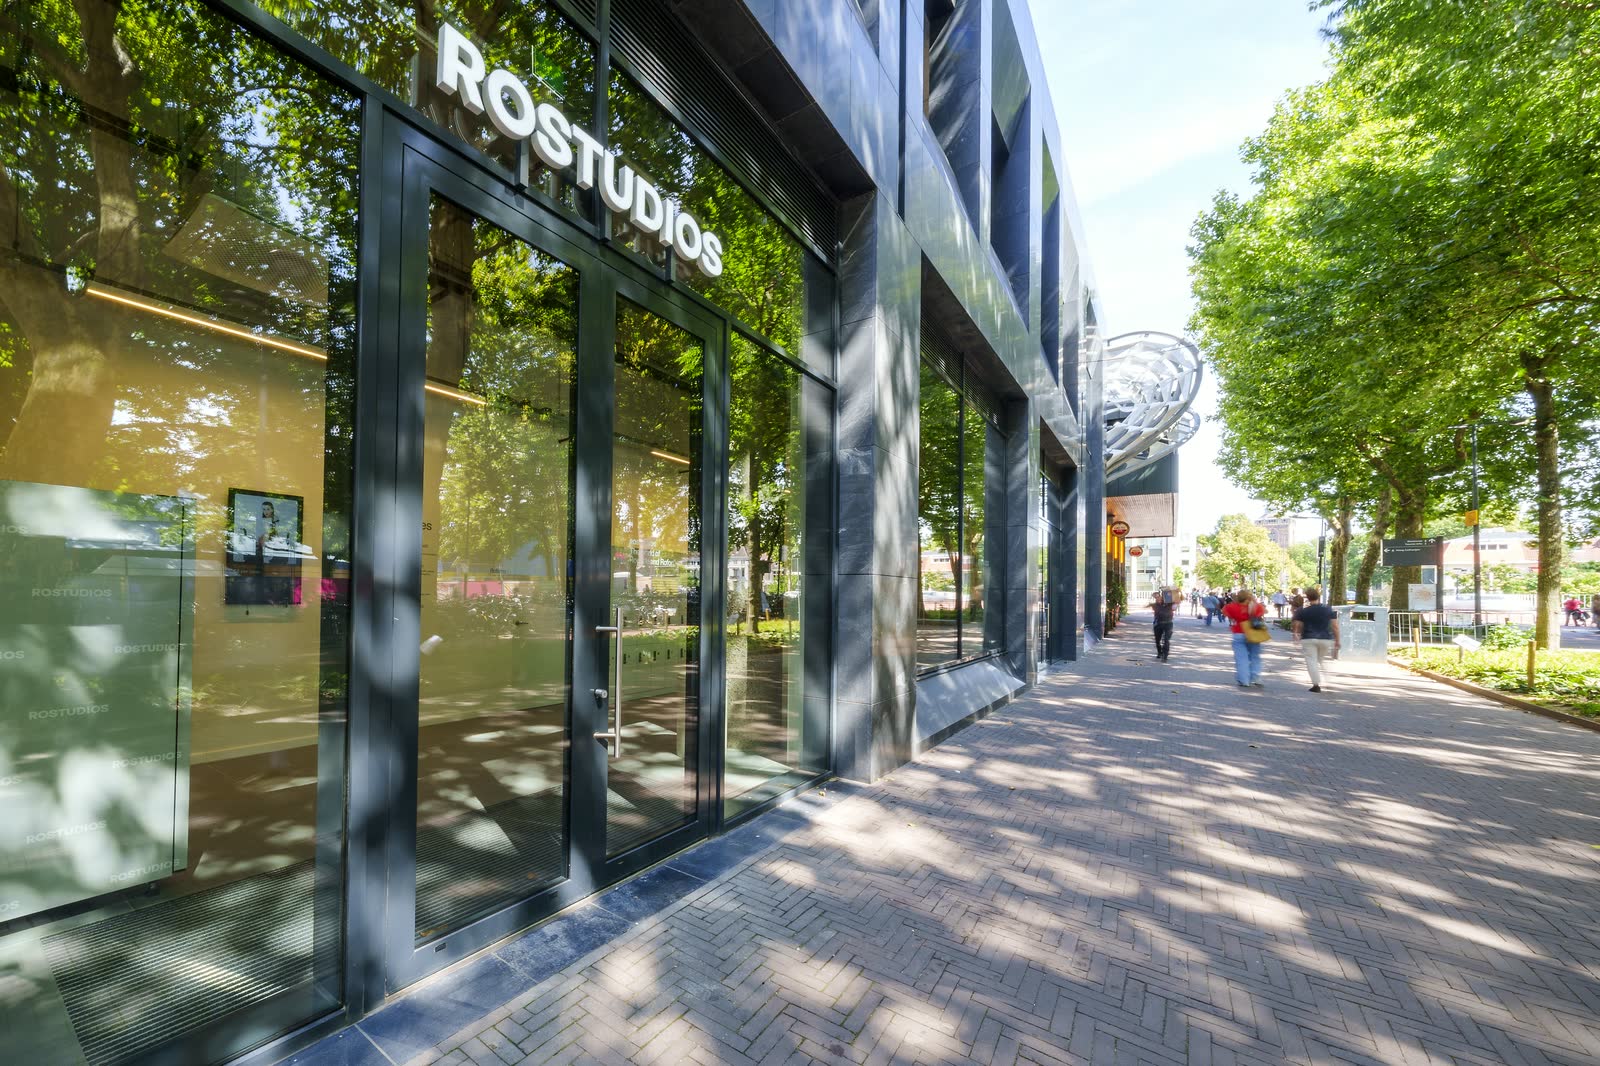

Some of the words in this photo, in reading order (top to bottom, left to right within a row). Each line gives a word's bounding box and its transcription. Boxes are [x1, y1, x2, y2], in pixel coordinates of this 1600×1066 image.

[436, 22, 723, 278] ROSTUDIOS
[31, 588, 112, 598] ROSTUDIOS
[113, 643, 185, 654] ROSTUDIOS
[29, 704, 109, 720] ROSTUDIOS
[112, 751, 182, 769] ROSTUDIOS
[26, 820, 107, 844] ROSTUDIOS
[110, 859, 180, 883] ROSTUDIOS
